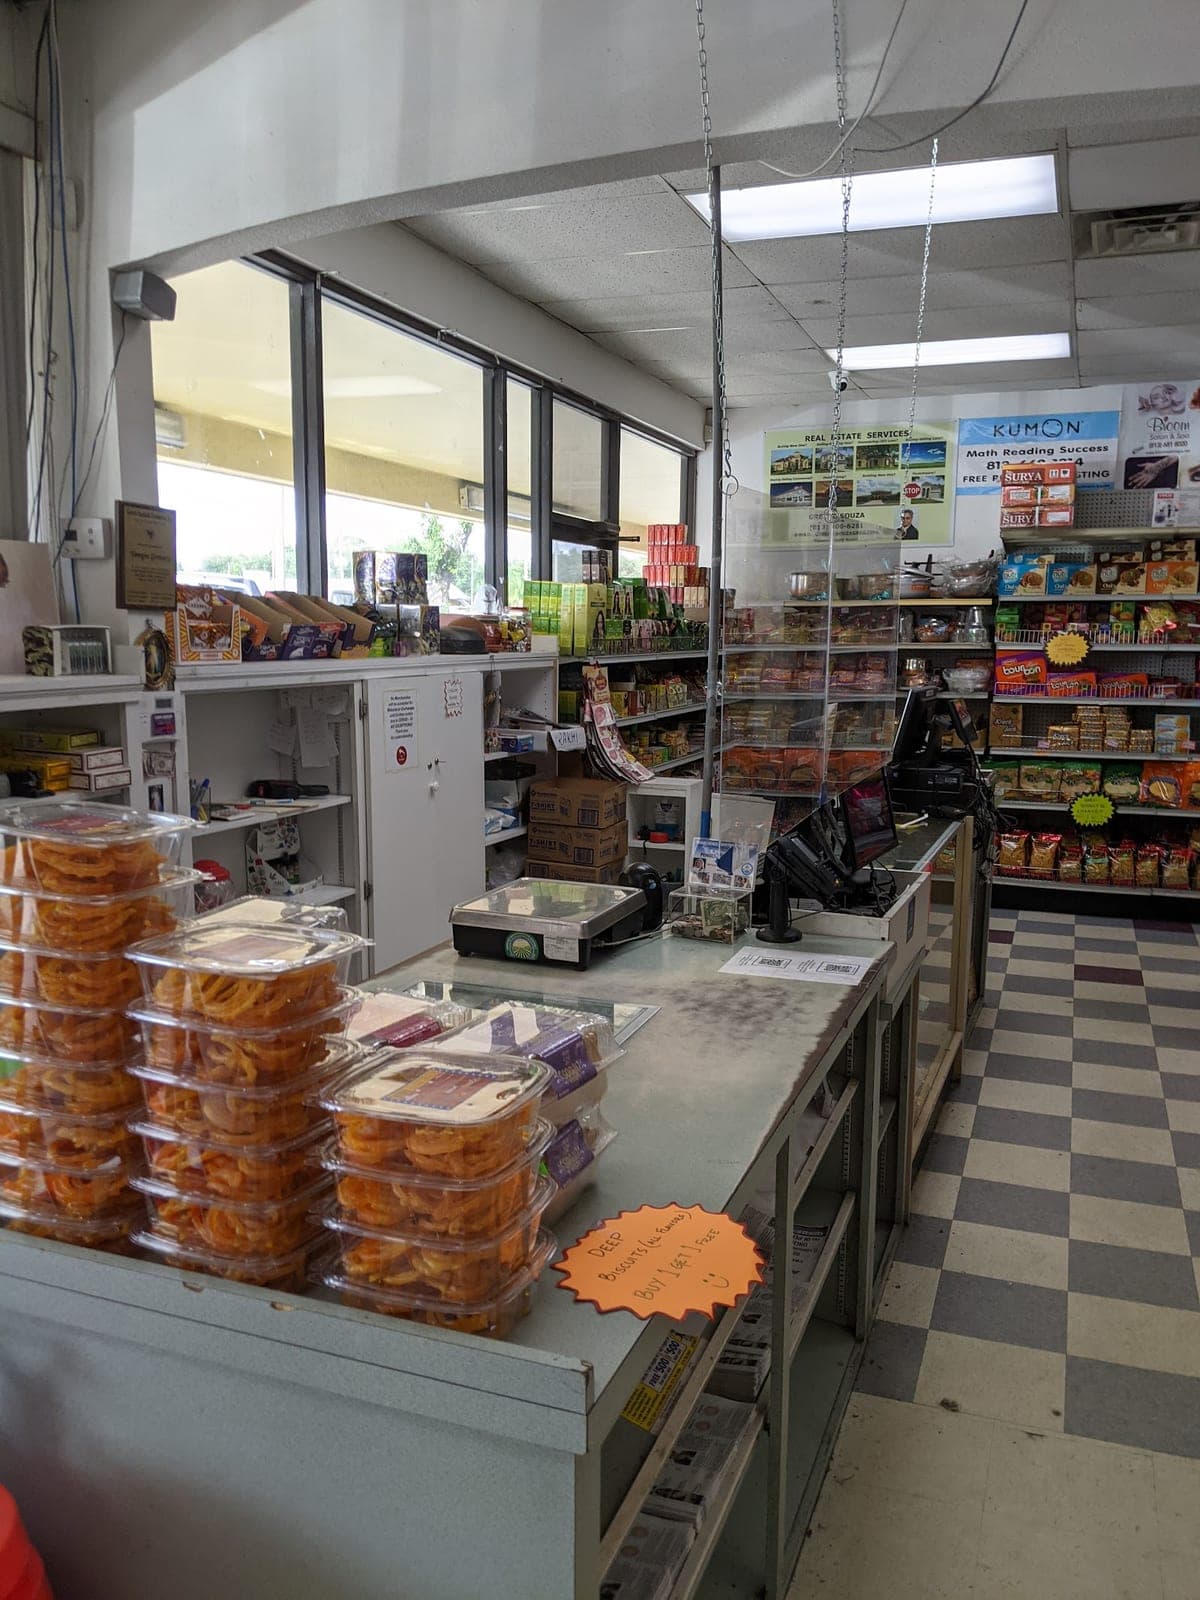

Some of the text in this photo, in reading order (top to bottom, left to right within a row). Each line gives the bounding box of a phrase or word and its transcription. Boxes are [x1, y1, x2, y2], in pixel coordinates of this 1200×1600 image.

[993, 418, 1081, 438] KUMON
[1146, 416, 1190, 432] Bloom
[805, 434, 826, 442] REAL
[867, 430, 910, 439] SERVICES
[966, 444, 1109, 458] Math Reading Success
[963, 475, 987, 483] FREE
[1004, 471, 1043, 482] SURYA
[904, 487, 921, 496] STOP
[1002, 664, 1041, 676] bourbon
[588, 1232, 624, 1257] DEEP
[598, 1246, 648, 1282] BISCUITS
[634, 1277, 666, 1300] BUY
[657, 1268, 681, 1279] 1
[670, 1252, 693, 1270] GET
[695, 1228, 720, 1246] FREE
